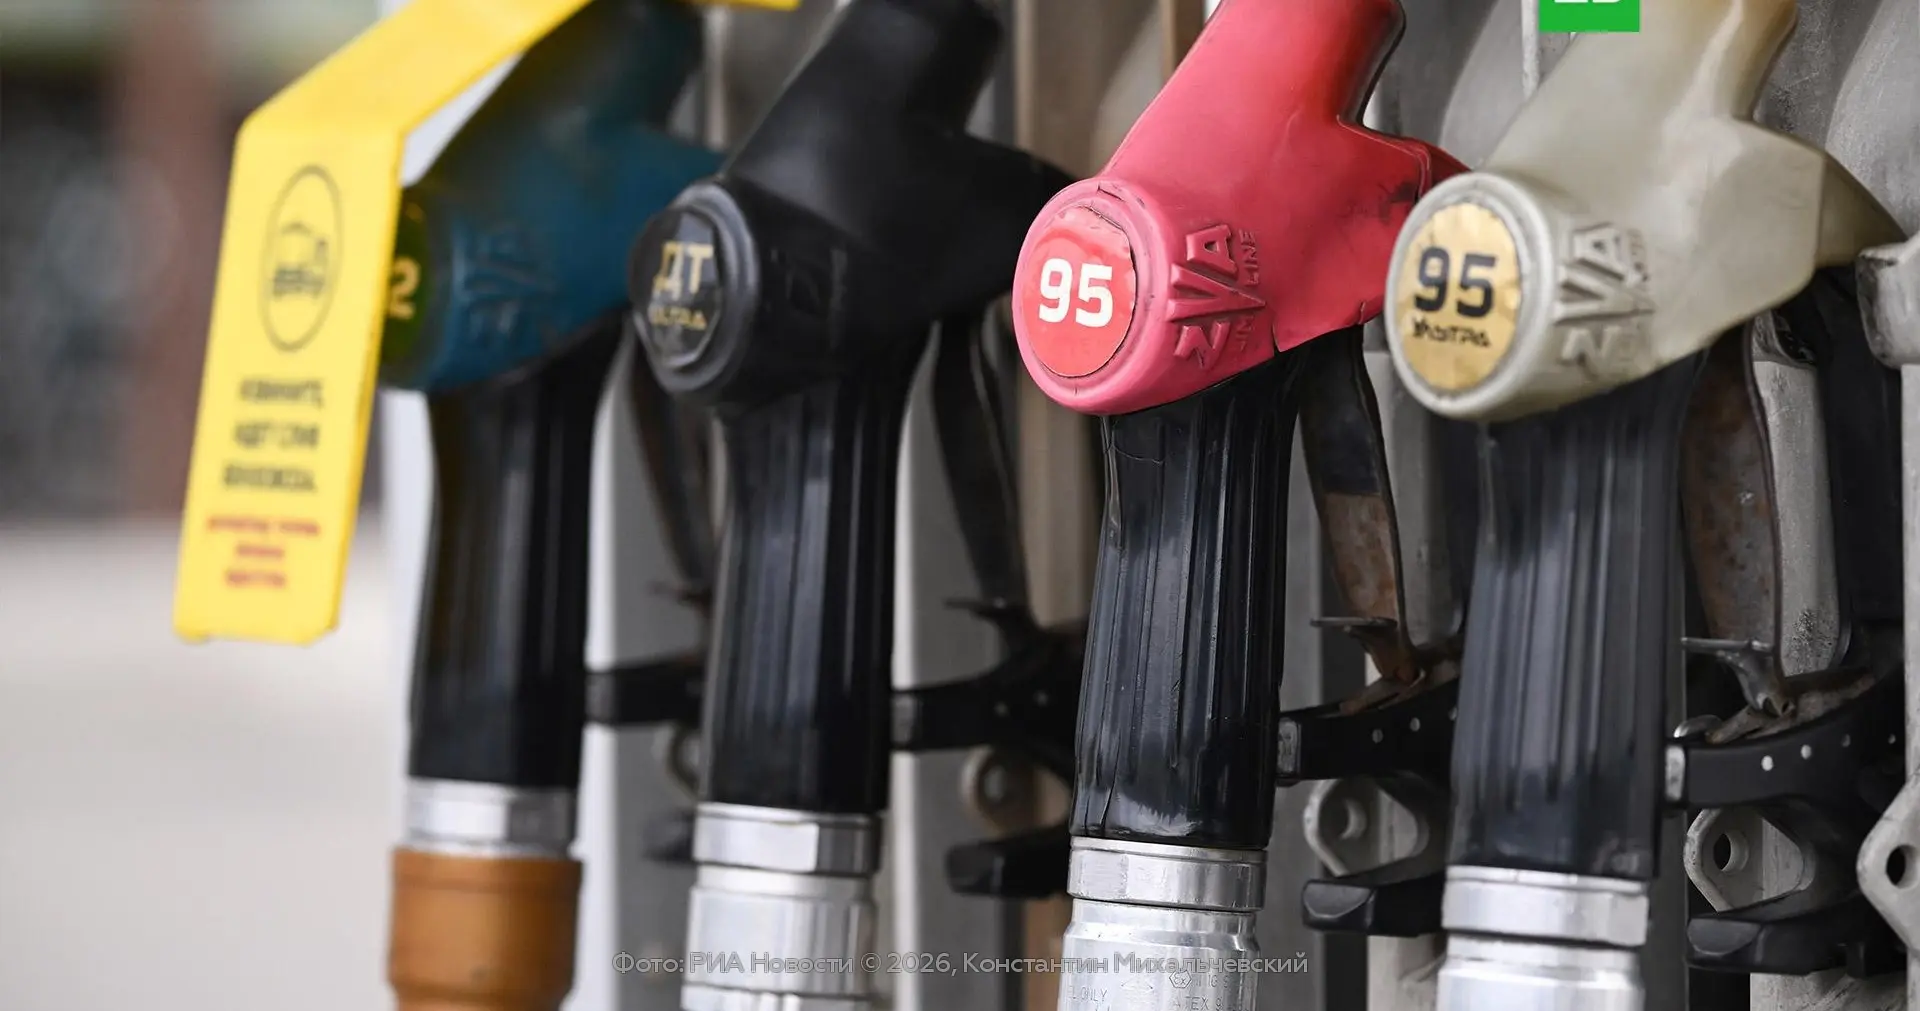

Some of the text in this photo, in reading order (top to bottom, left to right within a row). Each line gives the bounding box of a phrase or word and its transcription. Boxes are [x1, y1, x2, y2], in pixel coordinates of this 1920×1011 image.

[388, 256, 420, 320] 2
[651, 241, 714, 301] ДТ
[1239, 229, 1260, 287] LINE
[1414, 247, 1496, 318] 95
[1038, 258, 1114, 328] 95
[1166, 224, 1266, 368] ZVA
